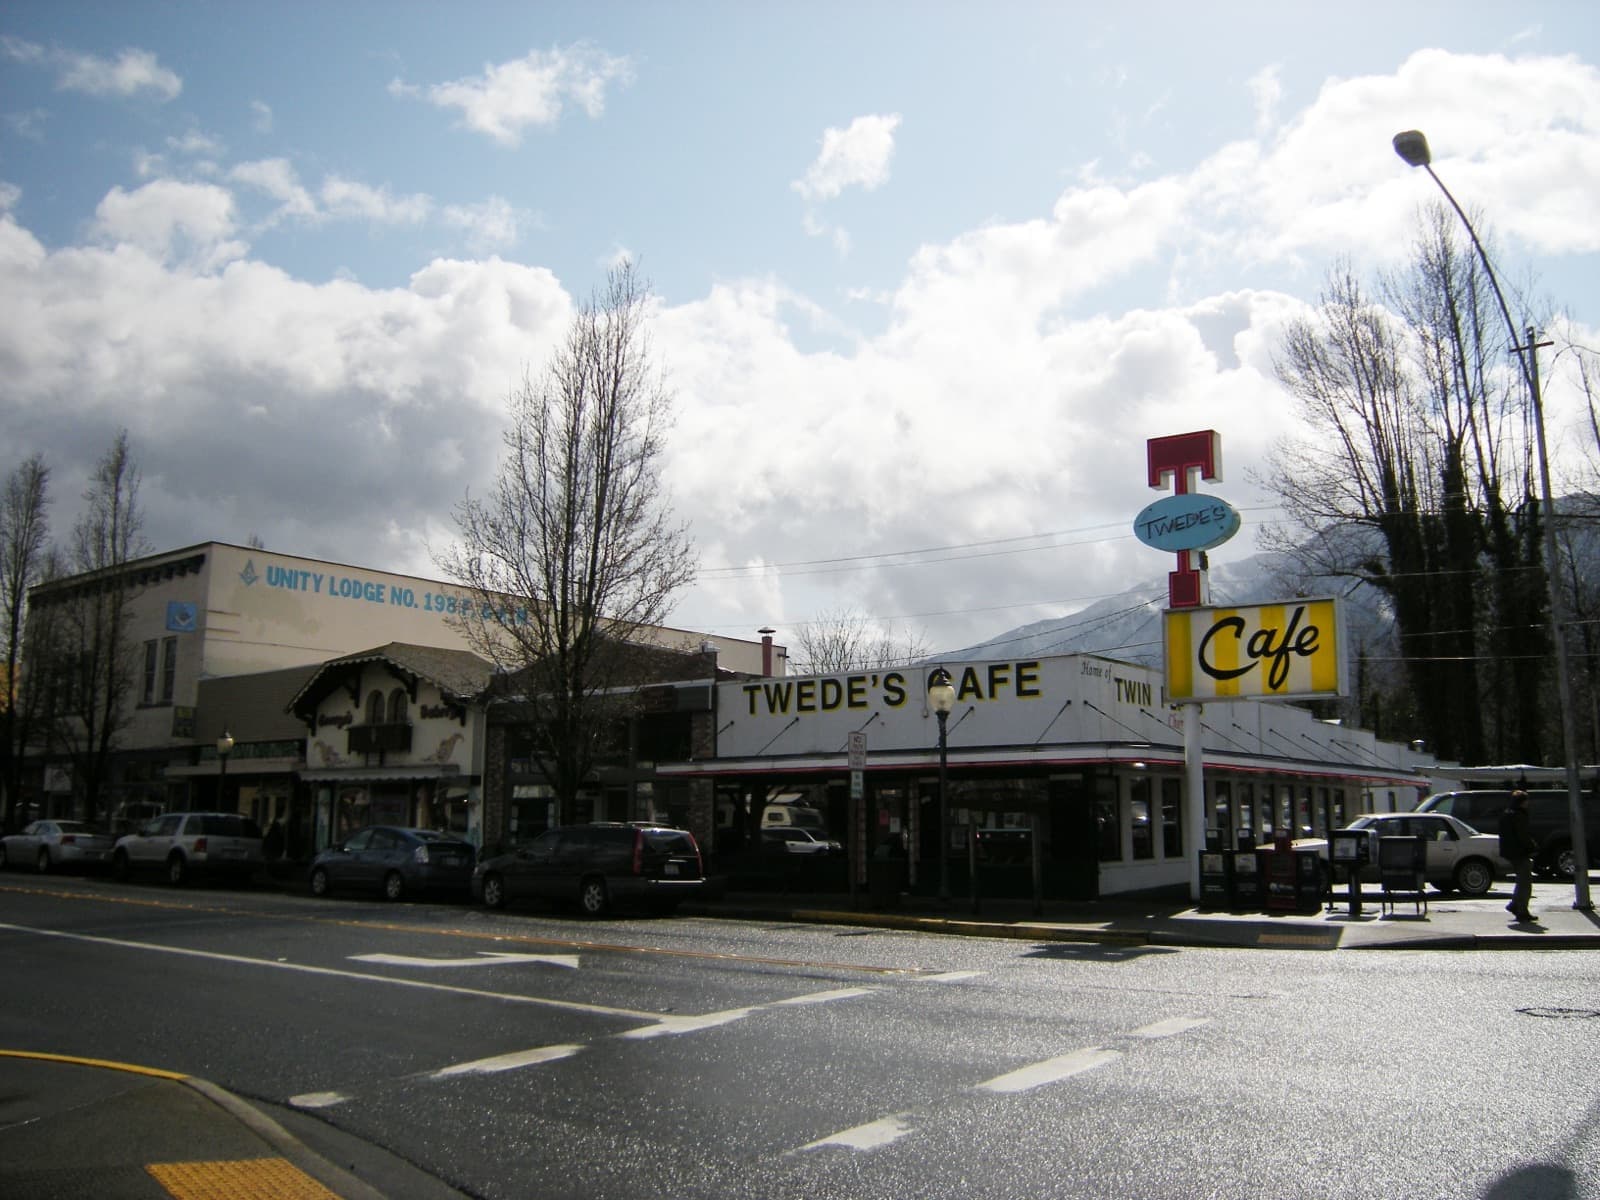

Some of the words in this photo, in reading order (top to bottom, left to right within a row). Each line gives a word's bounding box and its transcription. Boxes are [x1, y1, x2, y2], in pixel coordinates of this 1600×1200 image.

[1139, 505, 1226, 539] TWEDE'S
[266, 565, 324, 593] UNITY
[329, 576, 385, 604] LODGE
[390, 586, 418, 609] NO.
[424, 592, 456, 615] 198
[1198, 606, 1319, 690] Cafe
[1080, 661, 1103, 678] Home
[1104, 664, 1113, 681] of
[743, 672, 906, 715] TWEDE'S
[1113, 677, 1152, 707] TWIN
